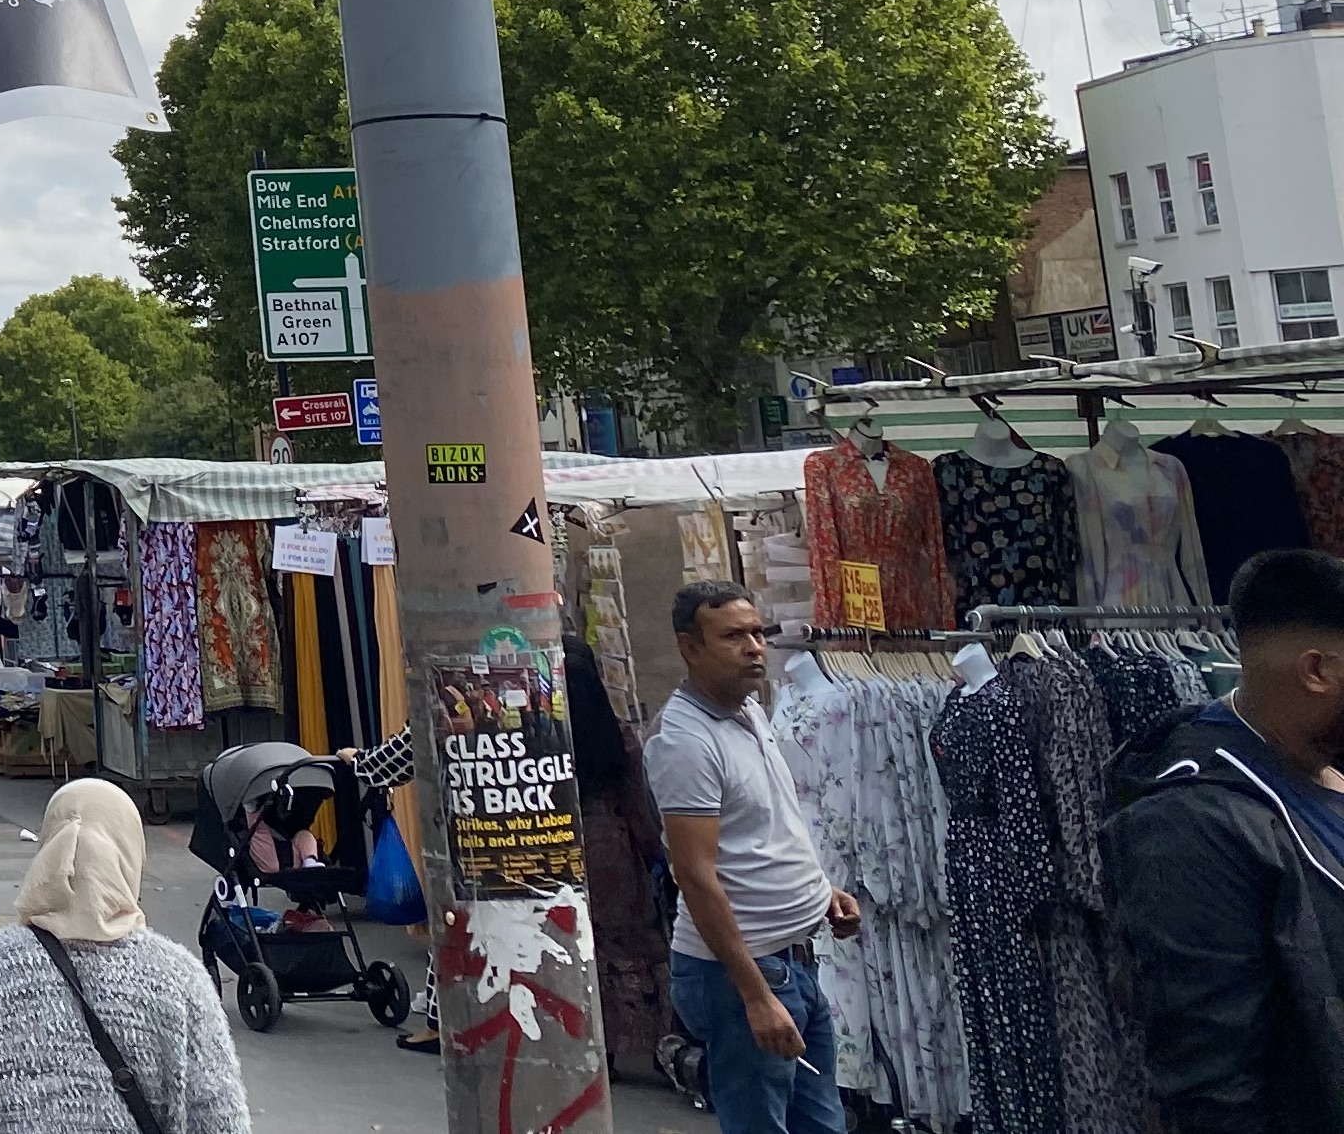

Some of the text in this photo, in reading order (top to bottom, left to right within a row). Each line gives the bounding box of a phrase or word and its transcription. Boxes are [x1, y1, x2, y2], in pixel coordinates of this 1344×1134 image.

[255, 178, 291, 192] Bow
[257, 193, 327, 209] Mile End
[259, 213, 356, 230] Chelmsford
[261, 235, 340, 251] Stratford
[272, 298, 337, 311] Bethnal
[282, 315, 332, 329] Green
[1067, 316, 1090, 337] UK
[277, 332, 319, 346] A107
[302, 398, 346, 411] Crossrail
[304, 411, 347, 423] SITE 107
[432, 447, 481, 462] BIZOK
[445, 732, 526, 760] CLASS
[448, 753, 573, 787] STRUGGLE
[452, 784, 555, 815] IS BACK
[456, 818, 503, 831] Strikes,
[506, 816, 532, 830] why
[489, 834, 516, 846] and
[520, 829, 574, 846] revolution
